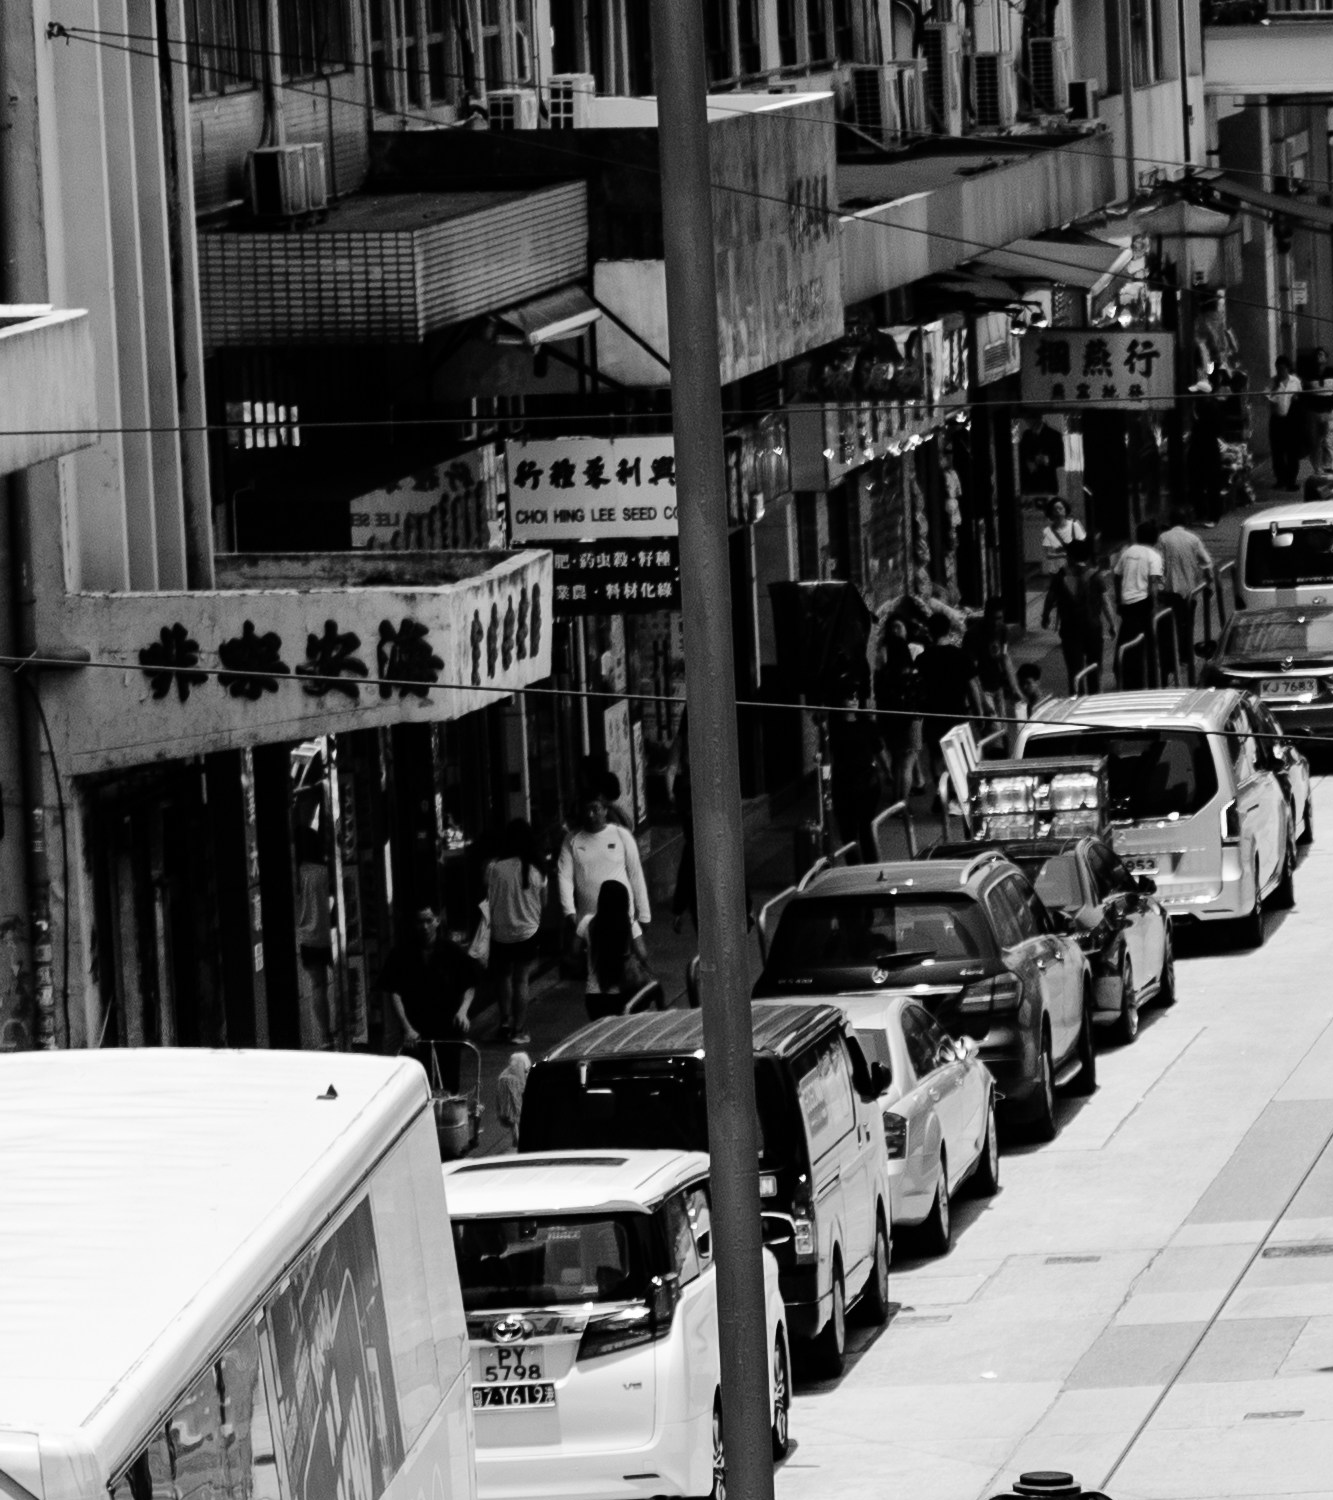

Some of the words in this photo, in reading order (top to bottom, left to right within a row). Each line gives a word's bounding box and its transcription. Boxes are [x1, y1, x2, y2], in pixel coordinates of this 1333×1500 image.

[516, 509, 548, 525] CHOI
[553, 509, 585, 523] HING
[591, 508, 617, 522] LEE
[622, 507, 658, 521] SEED
[498, 1346, 526, 1367] PY
[485, 1364, 542, 1382] 5798
